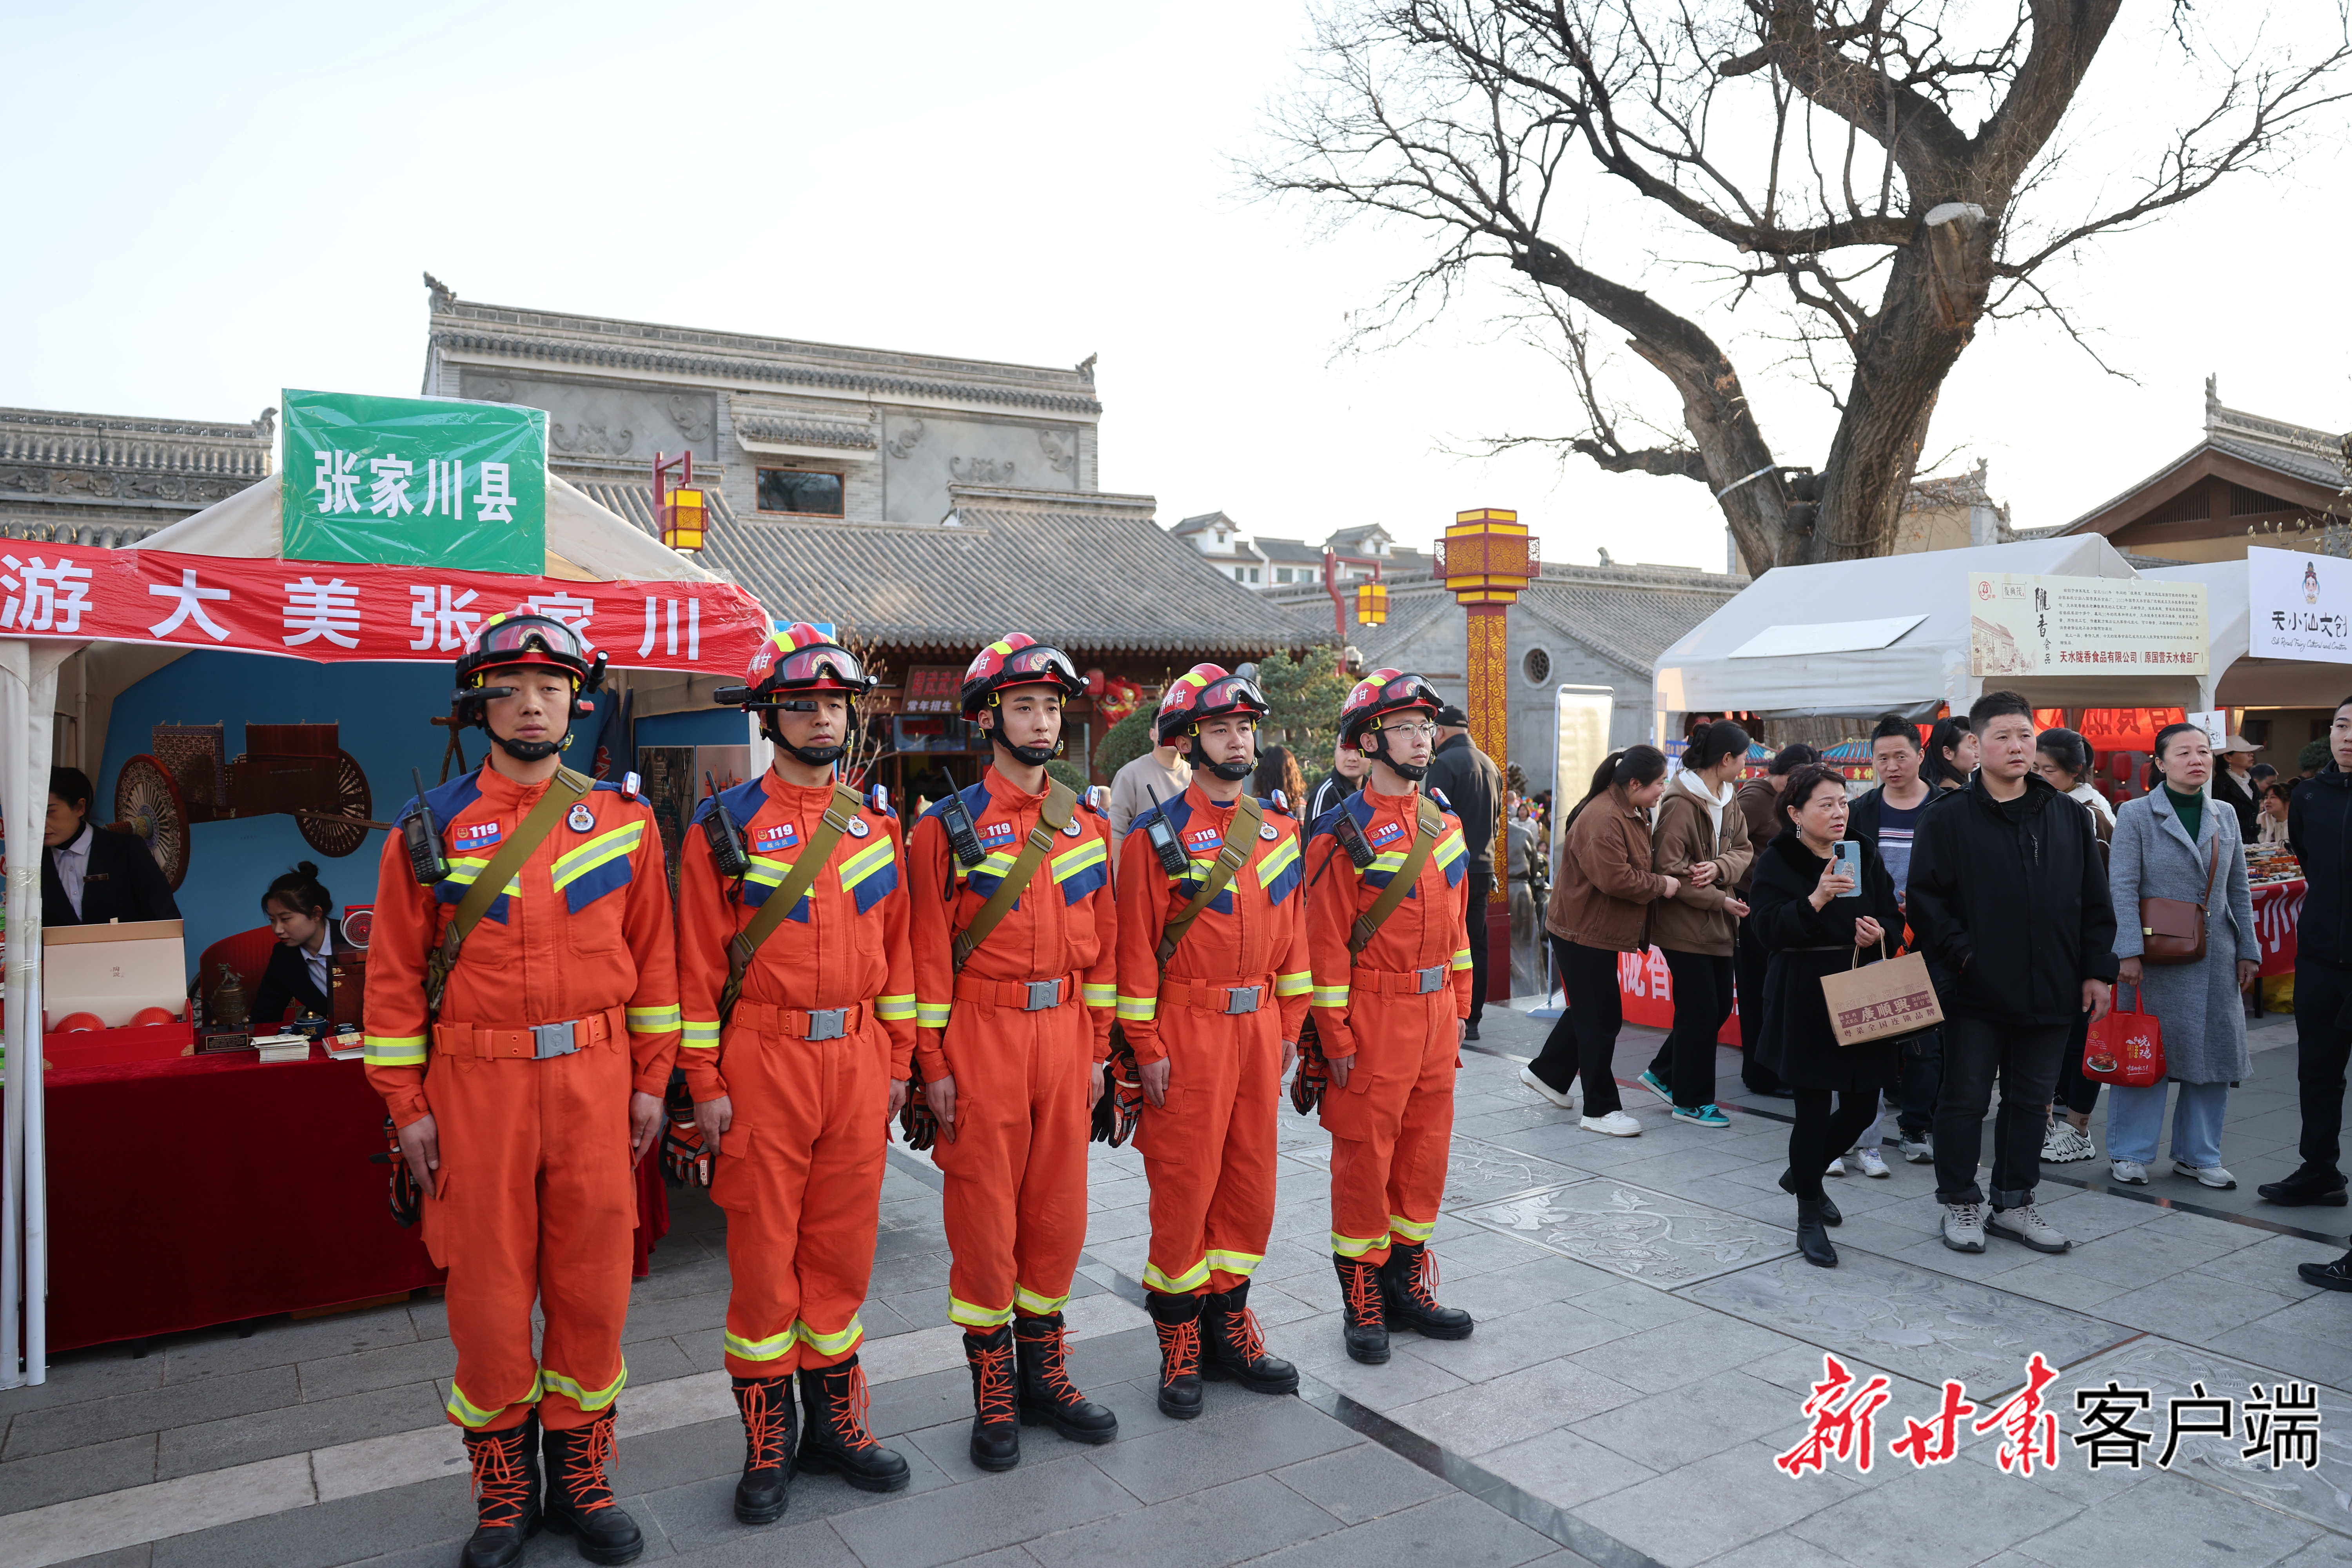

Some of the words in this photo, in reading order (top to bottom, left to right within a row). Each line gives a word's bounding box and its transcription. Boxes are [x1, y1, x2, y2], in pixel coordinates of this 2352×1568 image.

[316, 450, 517, 523] 张家川县
[2281, 637, 2293, 647] Road
[907, 700, 952, 711] 常年招生
[469, 823, 498, 838] 119
[768, 824, 793, 839] 119
[987, 823, 1011, 836] 119
[1194, 828, 1217, 841] 119
[1378, 823, 1398, 836] 119
[470, 838, 489, 847] 班长
[767, 839, 788, 849] 战斗员
[989, 837, 1005, 845] 班长
[1198, 841, 1213, 849] 班长
[1862, 998, 1911, 1022] 廣順興
[1844, 1008, 1936, 1038] 粤菜全国连锁品牌
